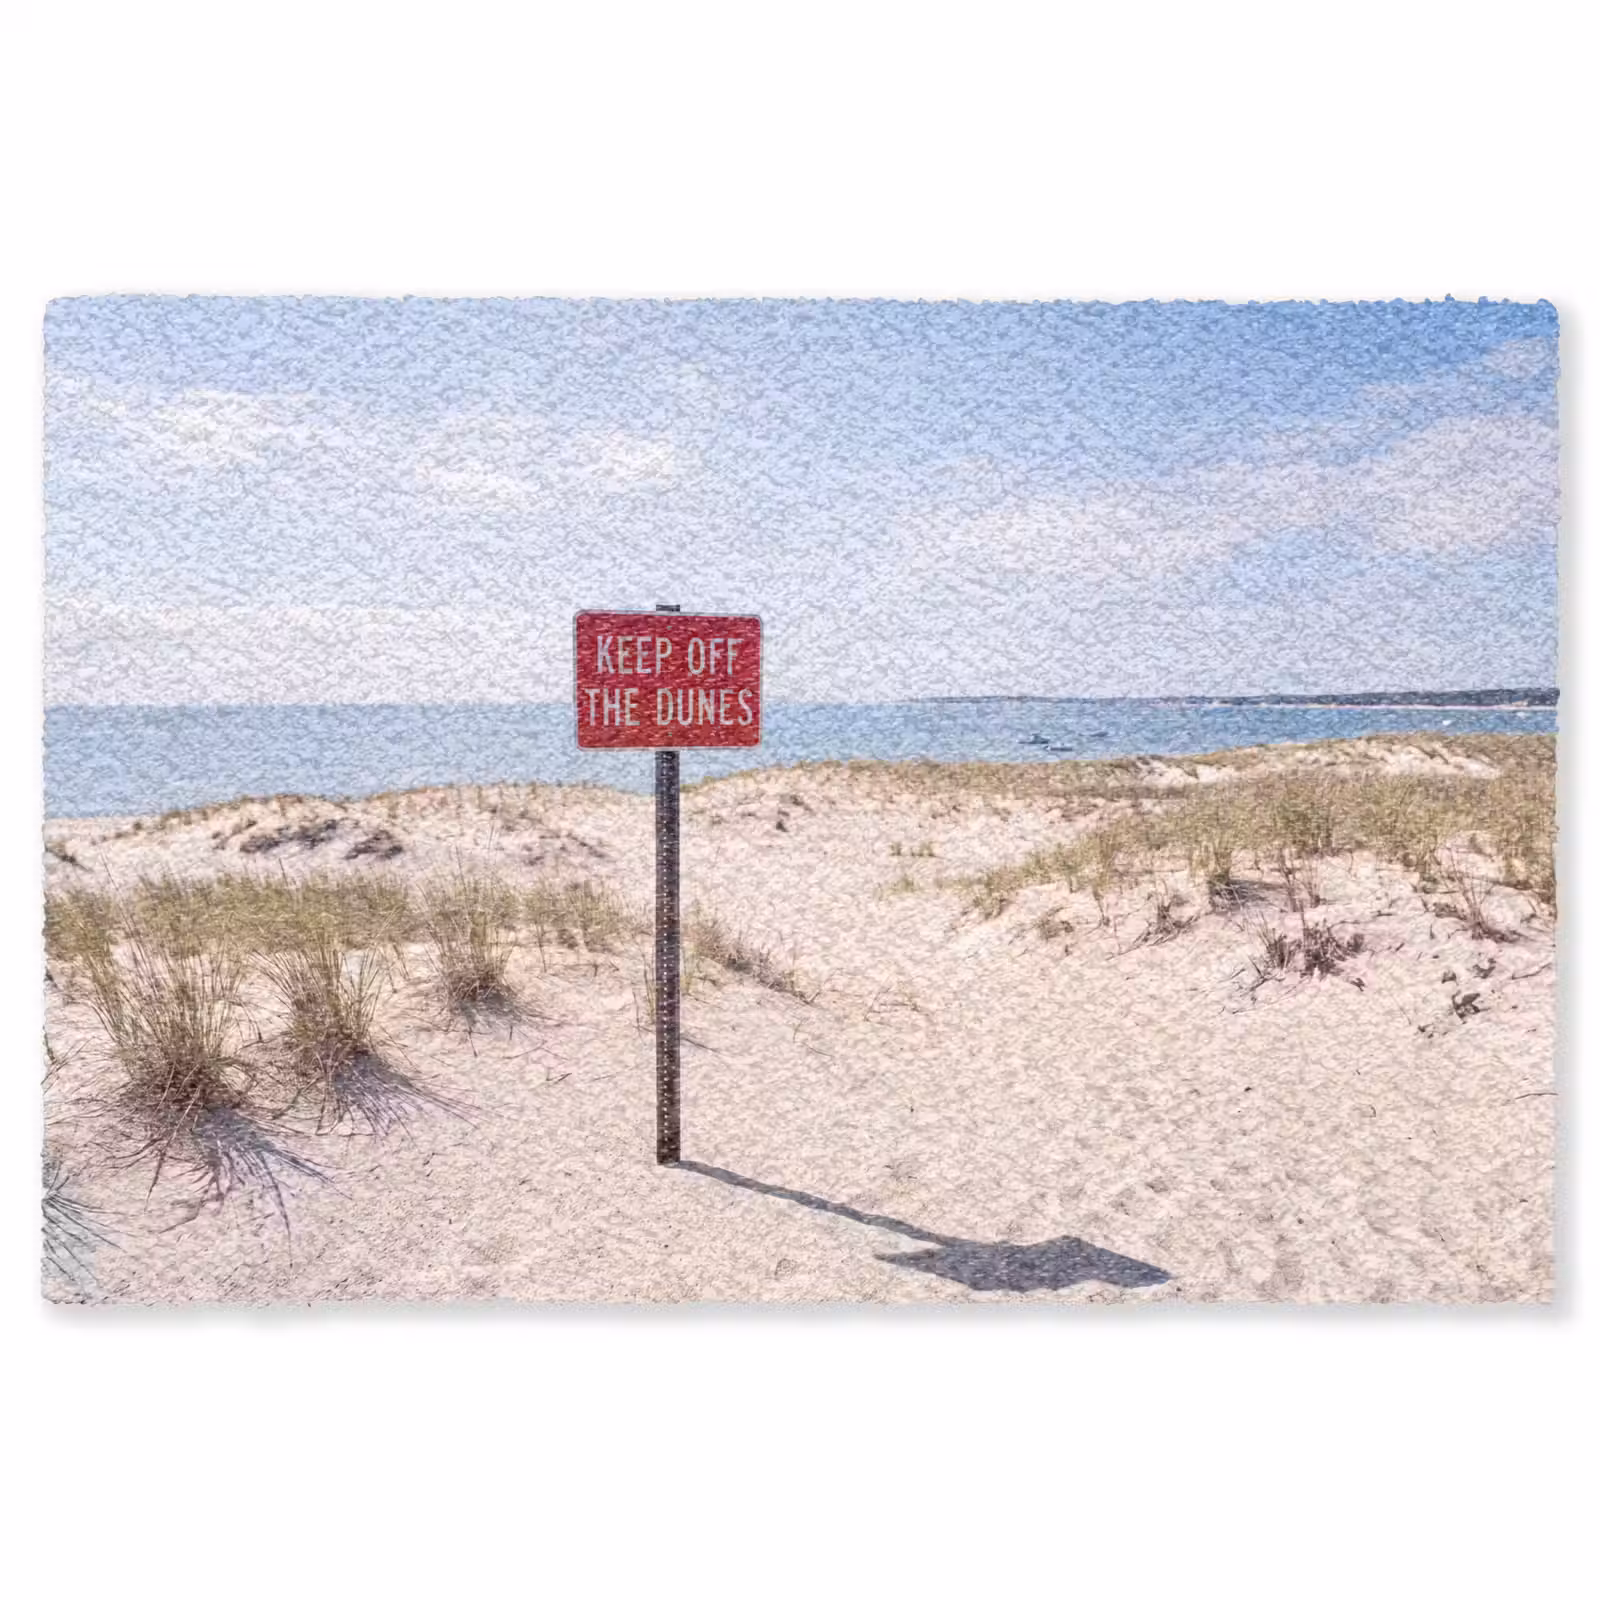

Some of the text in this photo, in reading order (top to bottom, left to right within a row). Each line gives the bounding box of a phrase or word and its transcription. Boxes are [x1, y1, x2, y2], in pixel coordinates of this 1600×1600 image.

[596, 635, 744, 676] KEEP OFF
[584, 687, 753, 726] THE DUNES
